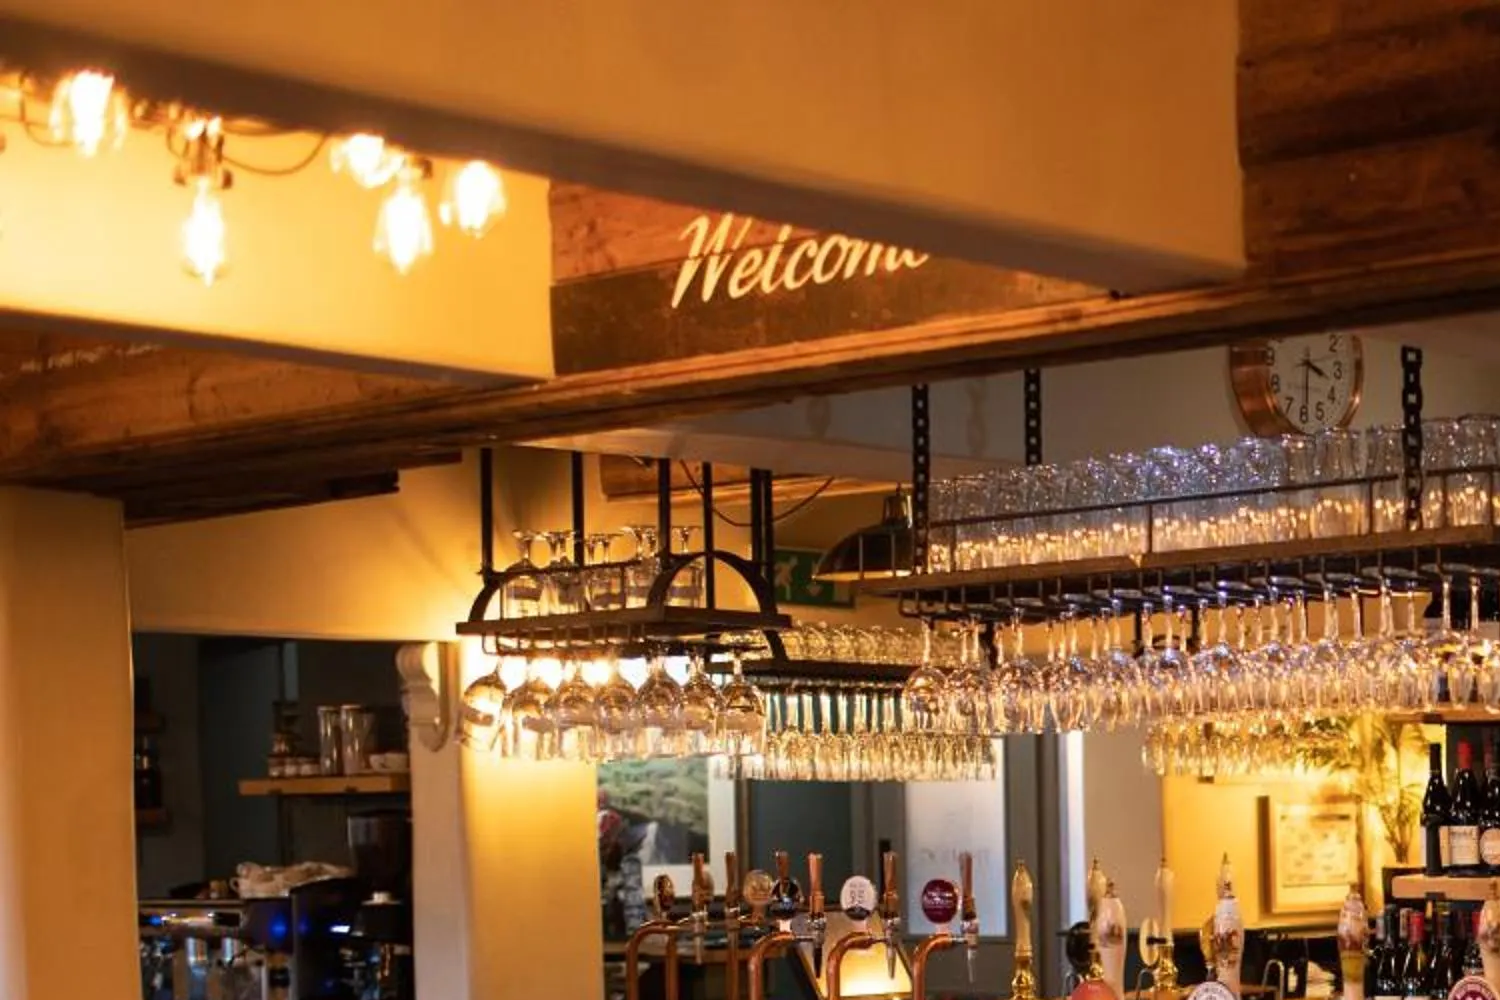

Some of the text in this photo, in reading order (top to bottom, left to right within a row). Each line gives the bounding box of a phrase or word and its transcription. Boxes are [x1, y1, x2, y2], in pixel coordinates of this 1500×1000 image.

[1333, 362, 1343, 380] 3
[1270, 374, 1281, 394] 8
[1327, 385, 1336, 405] 4
[1285, 397, 1295, 415] 7
[1315, 402, 1325, 422] 5
